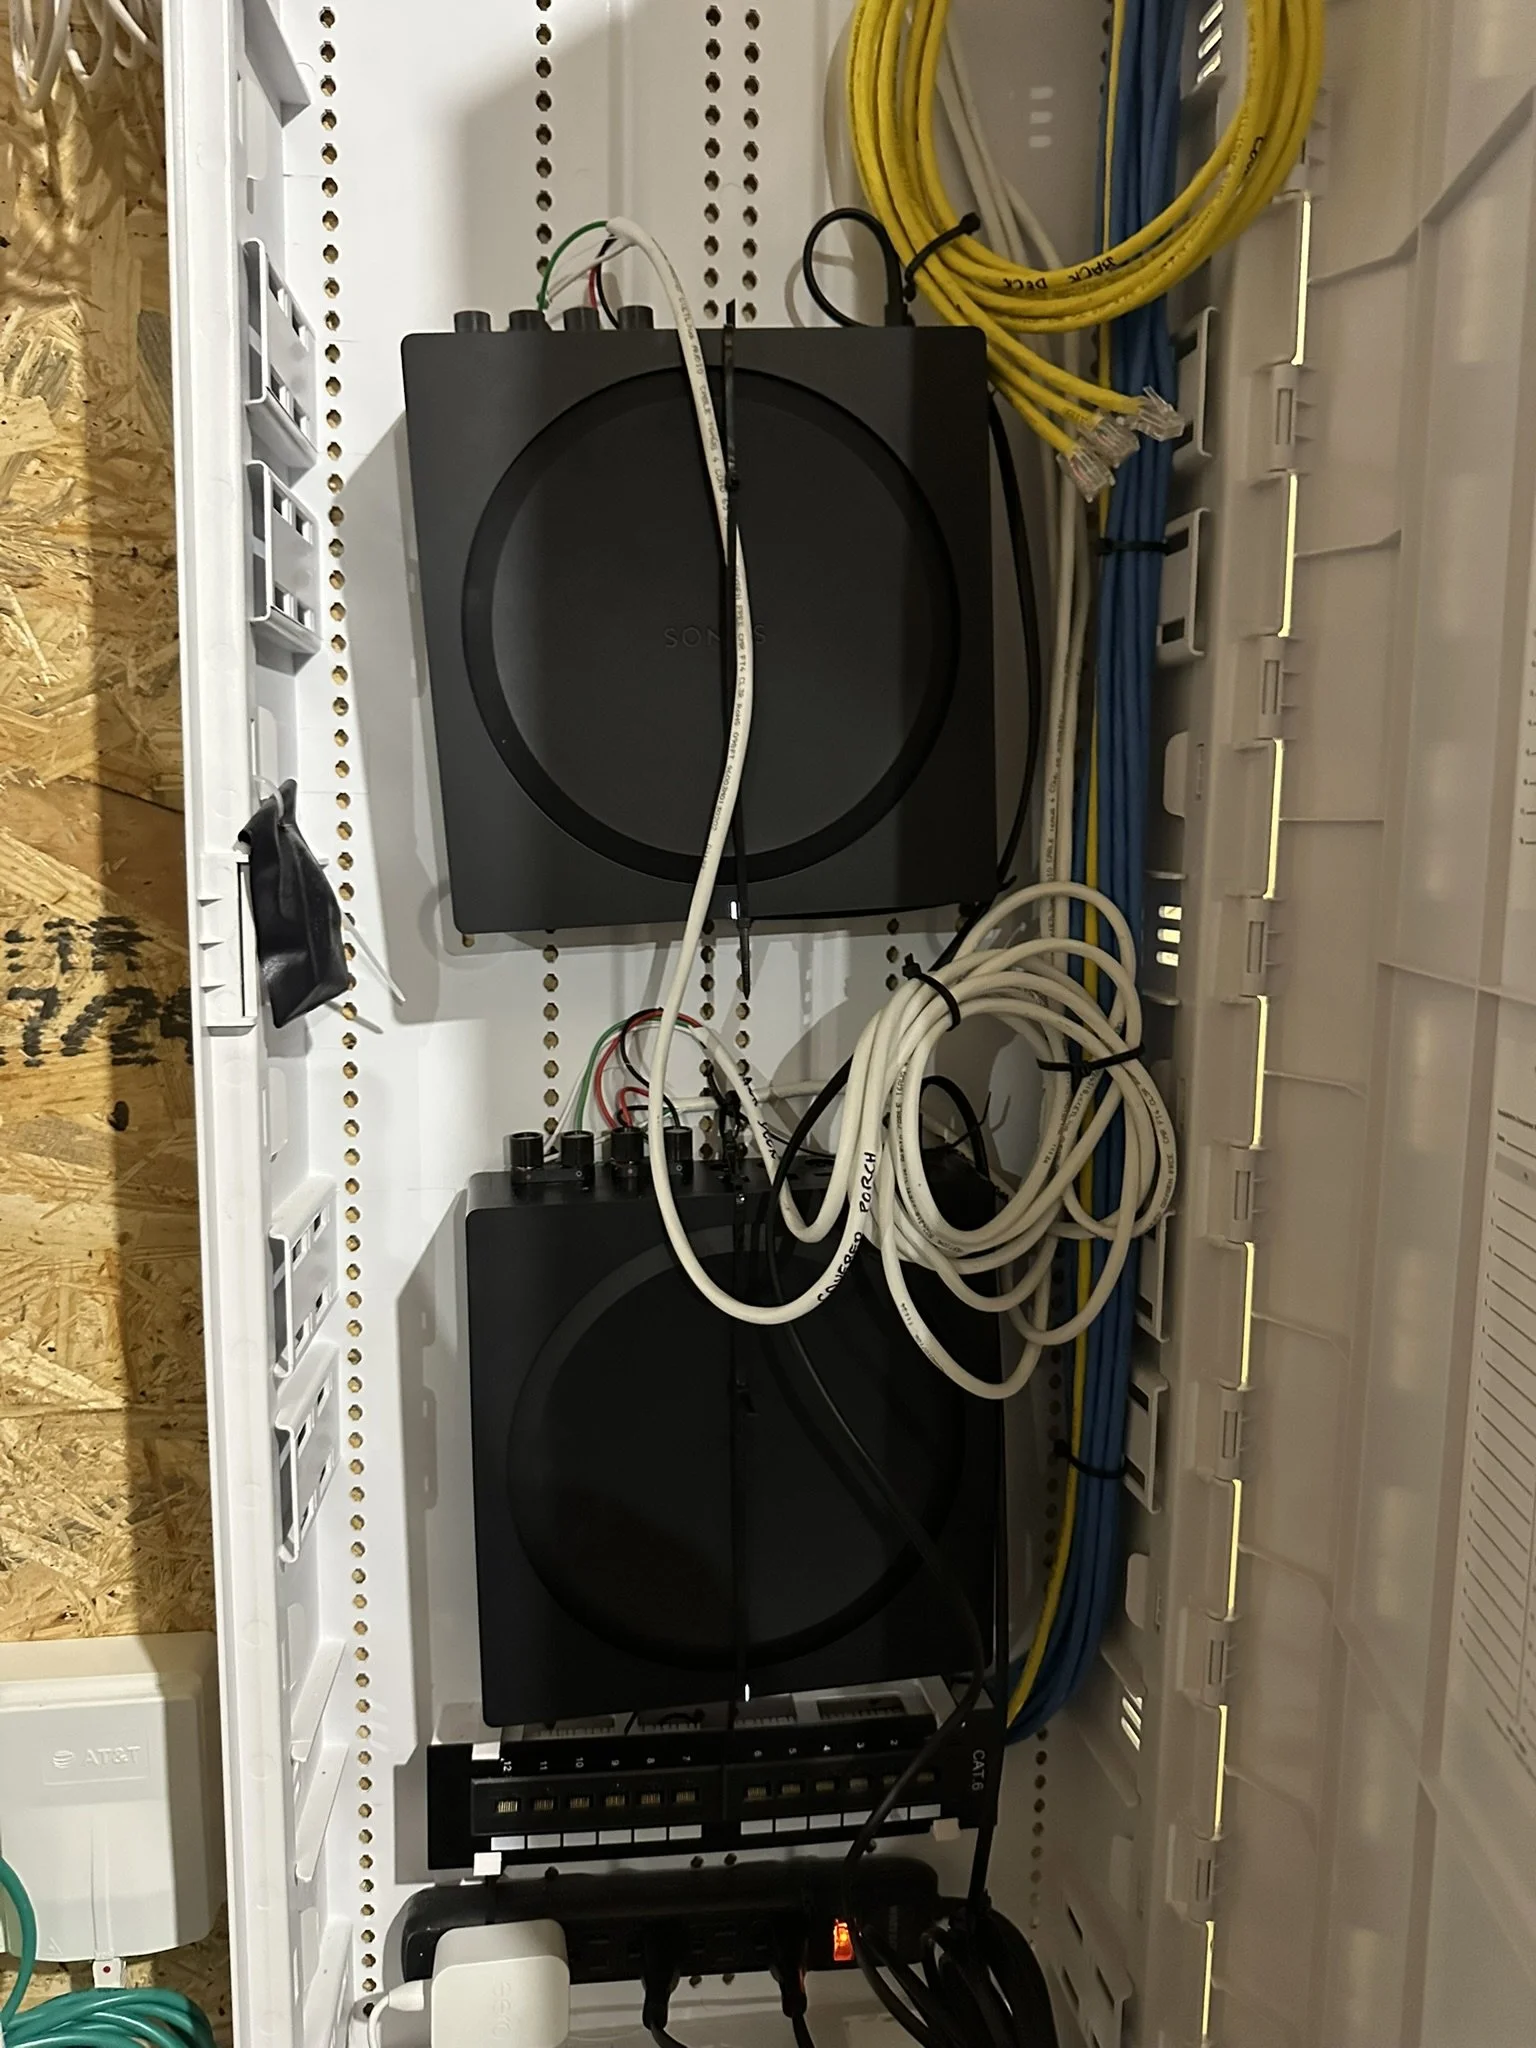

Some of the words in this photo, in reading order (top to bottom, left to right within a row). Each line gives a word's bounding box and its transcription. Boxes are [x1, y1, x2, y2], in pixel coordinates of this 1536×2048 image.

[1002, 277, 1048, 291] DECK
[663, 624, 767, 649] SONS
[859, 1151, 876, 1214] PORCH
[856, 1741, 865, 1750] 3
[890, 1738, 899, 1746] 2
[788, 1747, 797, 1755] 5
[822, 1744, 832, 1752] 4
[83, 1744, 141, 1766] AT&T
[681, 1754, 691, 1762] 7
[753, 1750, 763, 1758] 6
[502, 1759, 513, 1772] 12
[539, 1760, 548, 1772] 11
[575, 1756, 584, 1769] 10
[611, 1758, 620, 1767] 9
[646, 1757, 655, 1765] 8
[971, 1748, 986, 1792] CAT.6
